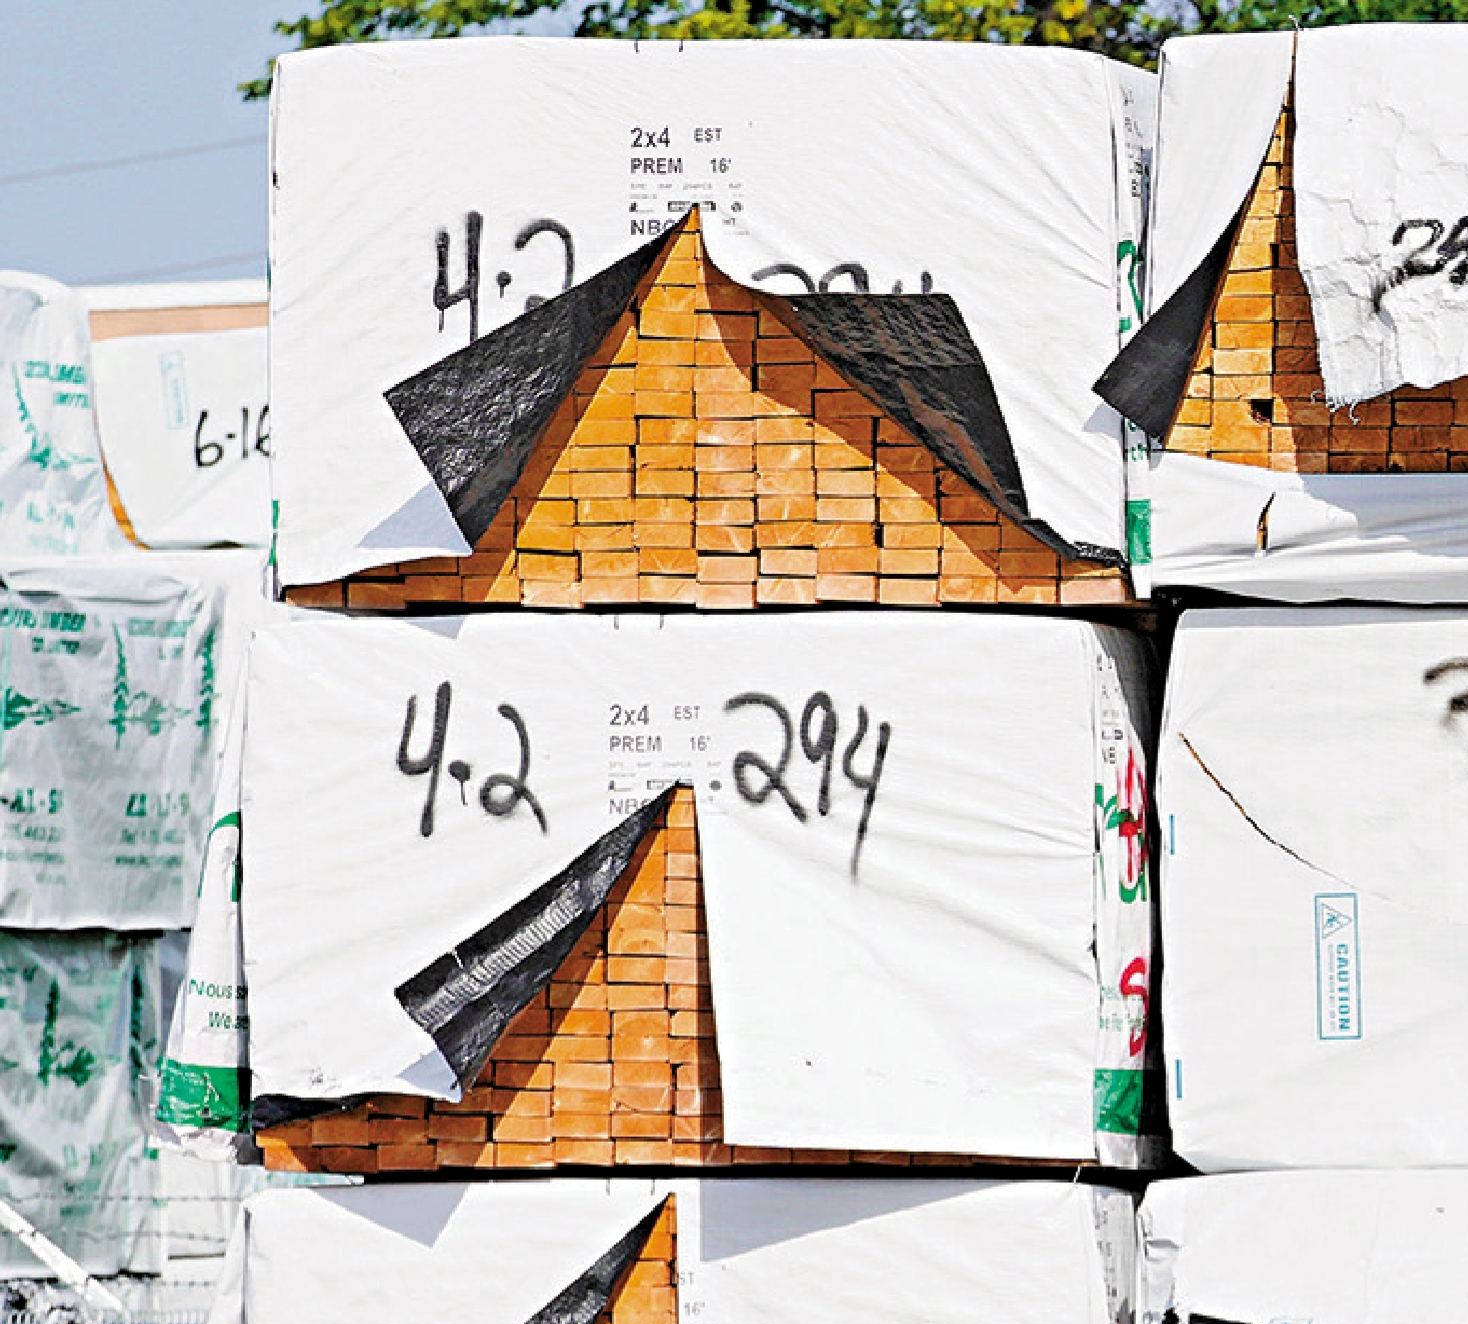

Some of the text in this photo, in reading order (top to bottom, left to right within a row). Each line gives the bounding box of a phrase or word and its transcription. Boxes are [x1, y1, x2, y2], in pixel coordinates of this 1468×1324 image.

[630, 125, 722, 148] 2x4 EST
[630, 157, 684, 174] PREM
[610, 704, 701, 726] 2x4 EST
[610, 735, 662, 752] PREM
[722, 690, 894, 885] 294
[1336, 943, 1351, 1031] CAUTION
